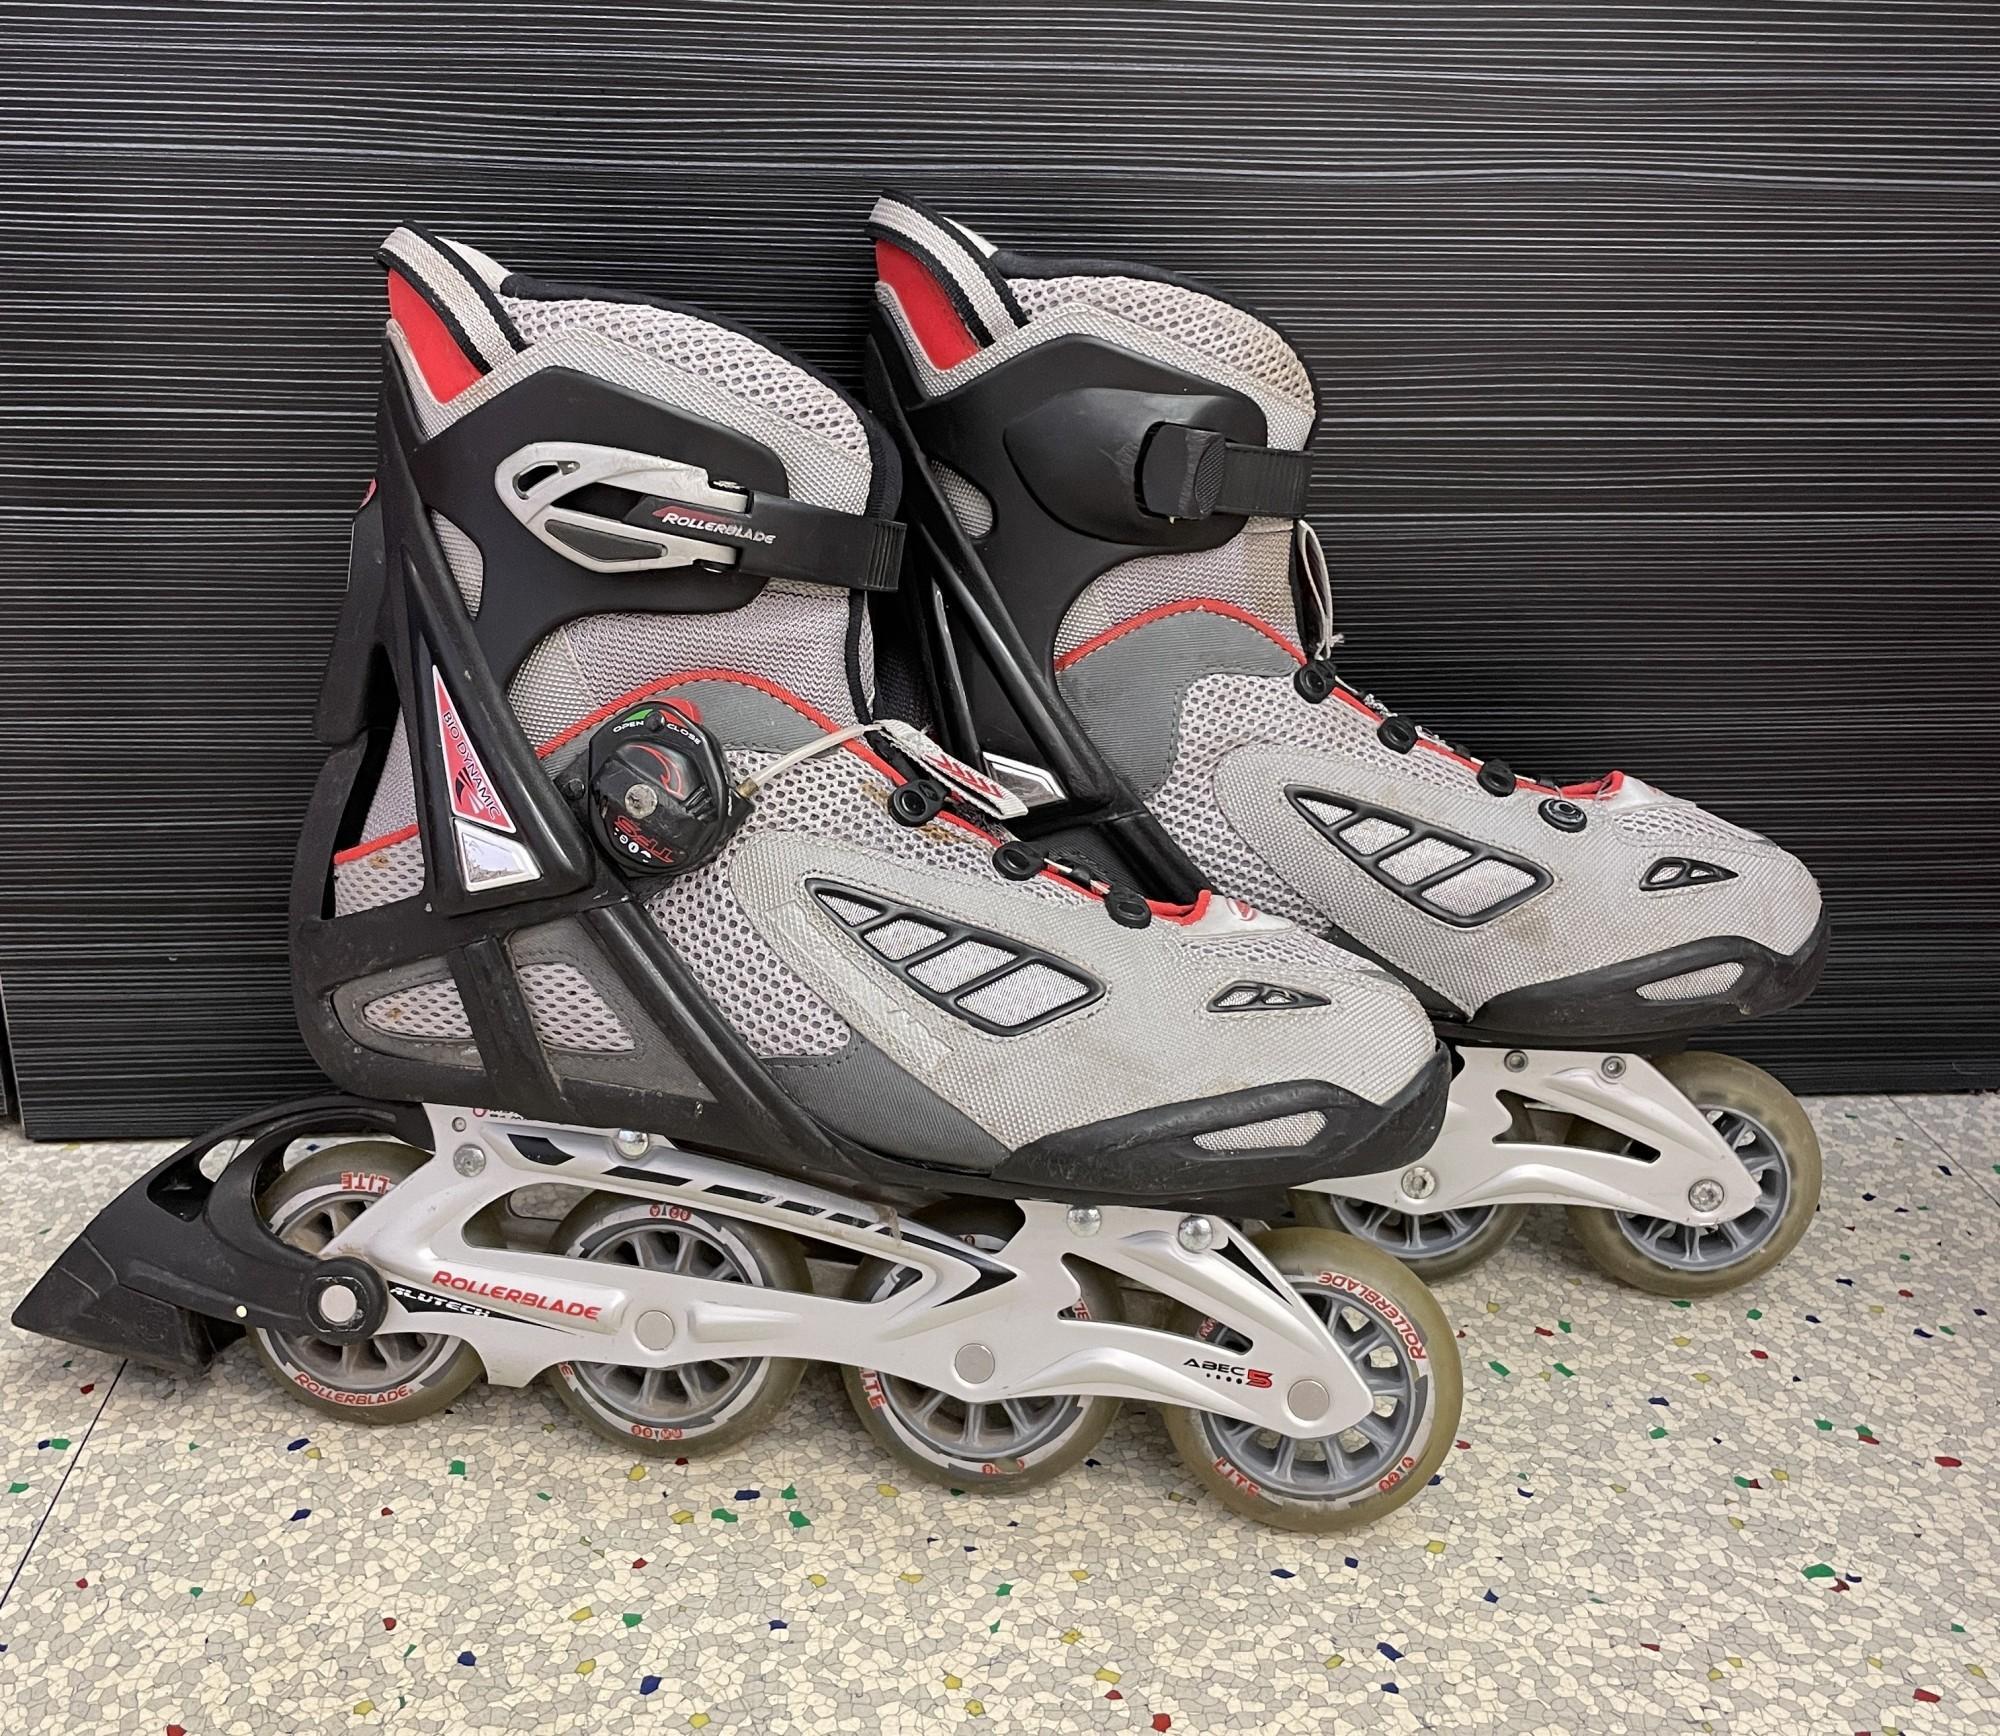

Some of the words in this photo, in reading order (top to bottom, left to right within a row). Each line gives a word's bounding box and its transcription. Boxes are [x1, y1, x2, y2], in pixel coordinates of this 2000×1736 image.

[662, 512, 777, 544] ROLLERBLADE
[612, 720, 645, 733] OPEN
[666, 723, 701, 745] CLOSE
[443, 711, 459, 739] BIO
[457, 742, 501, 820] DYNAMIC
[341, 1172, 389, 1194] LITE
[431, 1270, 602, 1320] ROLLERBLADE
[1319, 1271, 1427, 1360] ROLLERBLADE
[293, 1373, 410, 1405] ROLLERBLADE
[860, 1367, 886, 1409] ITE
